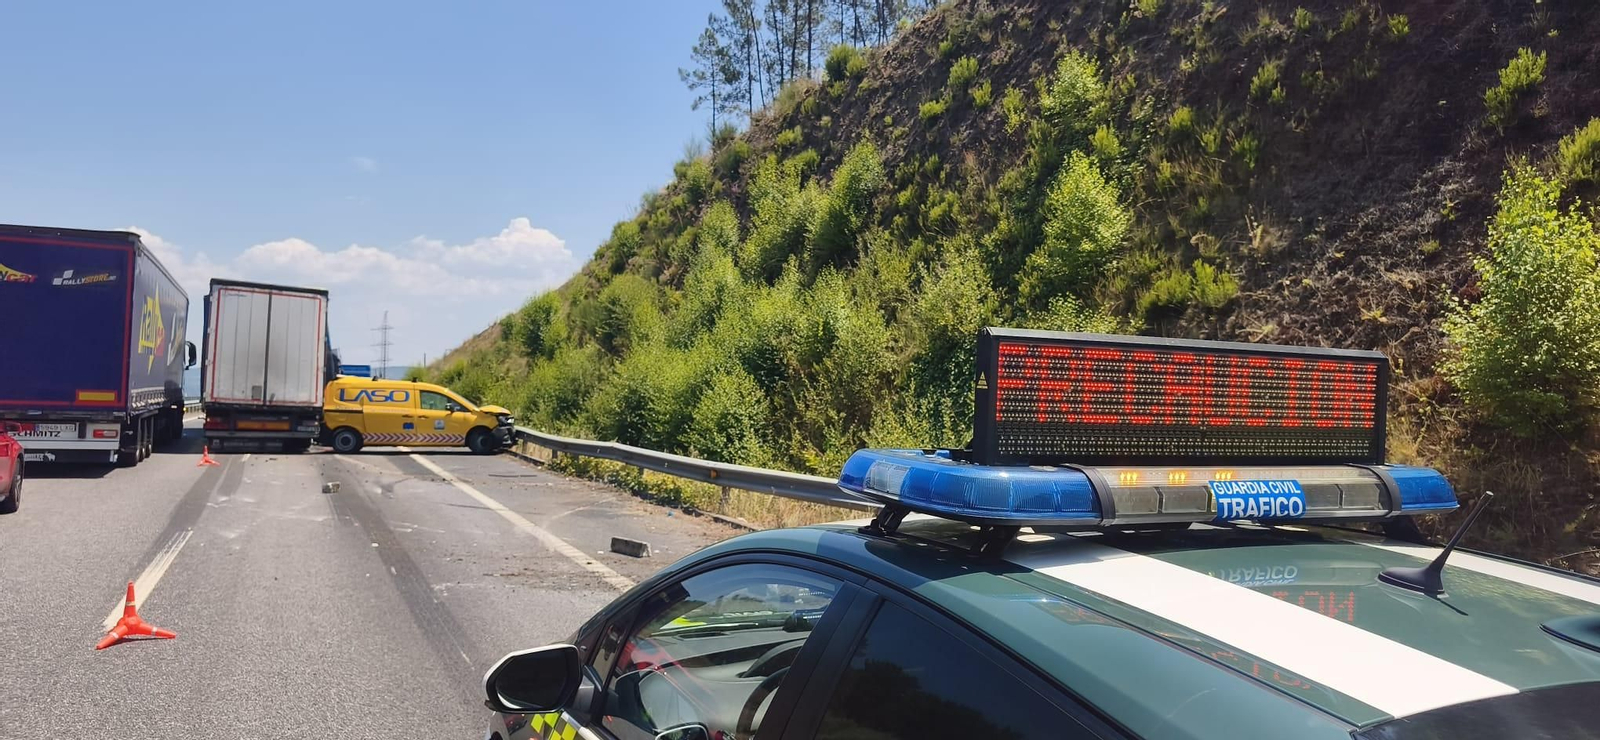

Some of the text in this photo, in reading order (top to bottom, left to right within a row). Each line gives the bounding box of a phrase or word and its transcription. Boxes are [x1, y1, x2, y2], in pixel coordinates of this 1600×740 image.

[997, 344, 1375, 428] PRECAUCION
[339, 388, 410, 402] LASO
[1213, 481, 1301, 495] GUARDIA CIVIL
[1219, 497, 1303, 518] TRAFICO
